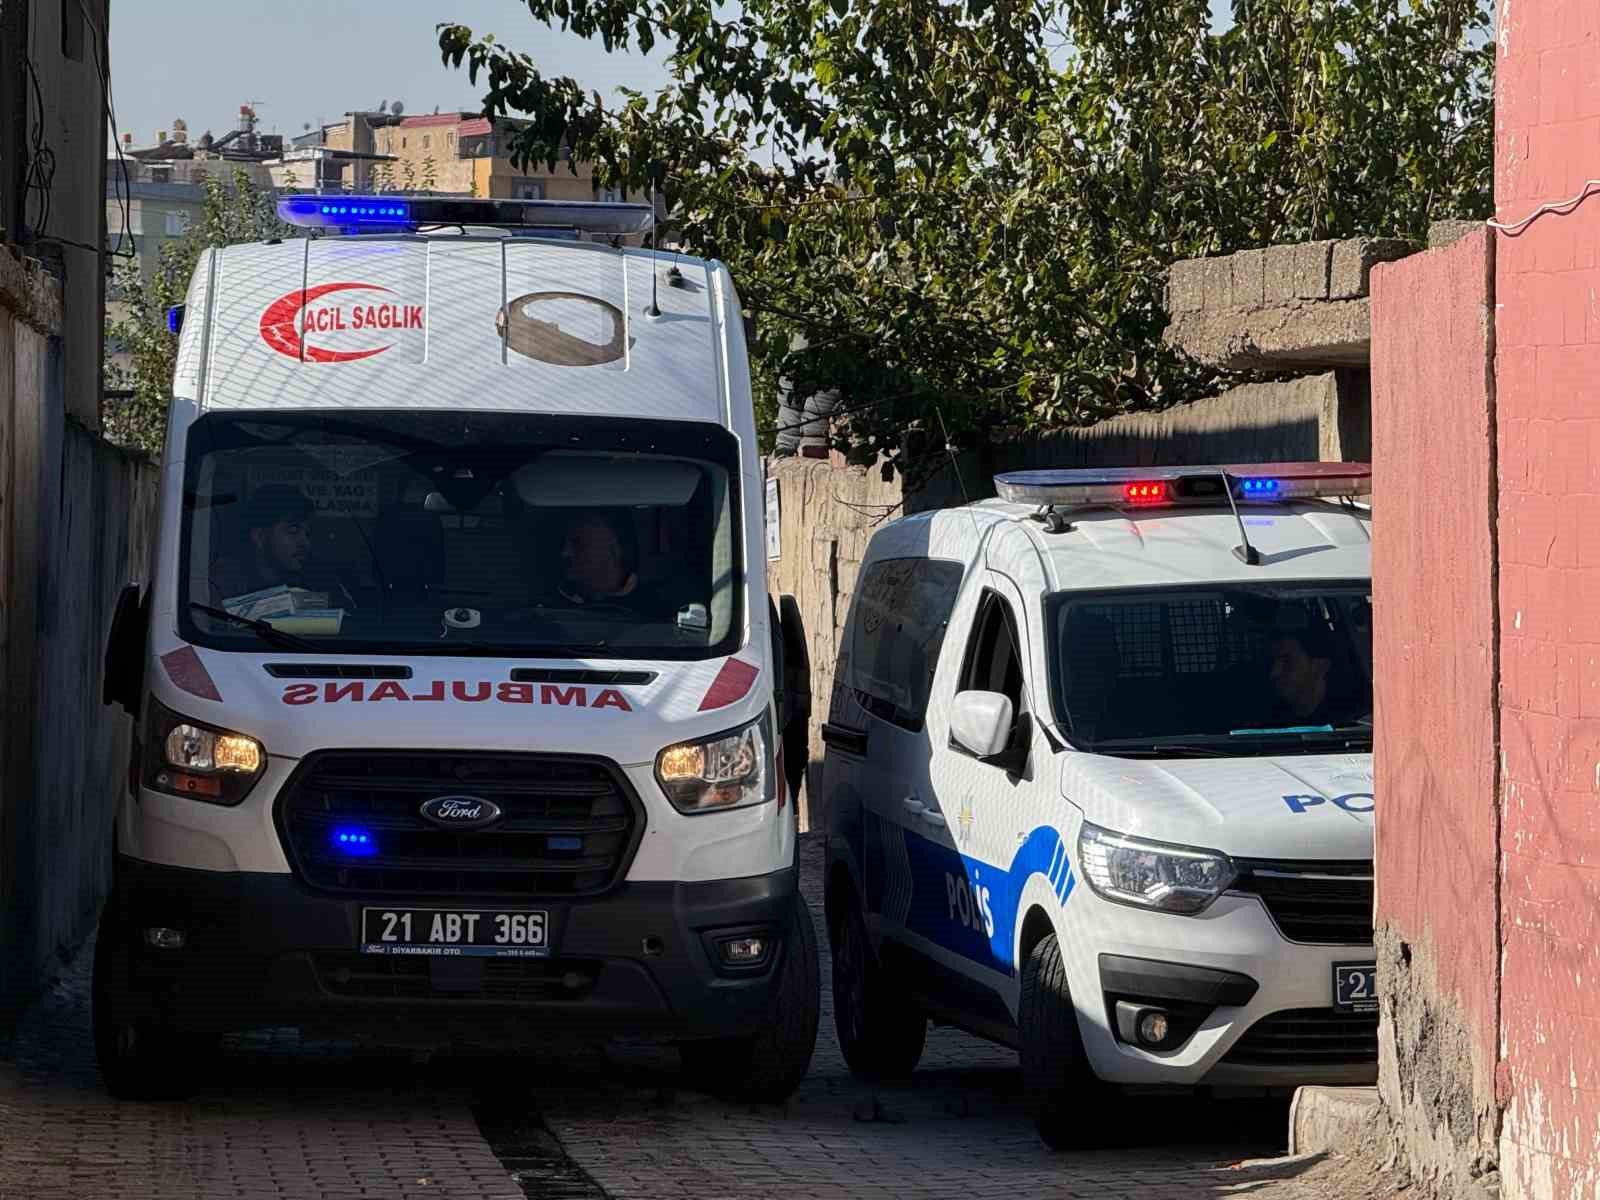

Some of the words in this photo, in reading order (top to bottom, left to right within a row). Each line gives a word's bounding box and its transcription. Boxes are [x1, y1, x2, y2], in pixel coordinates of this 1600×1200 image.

[438, 799, 482, 819] Ford
[381, 912, 412, 942] 21
[429, 913, 480, 943] ABT
[494, 914, 544, 944] 366
